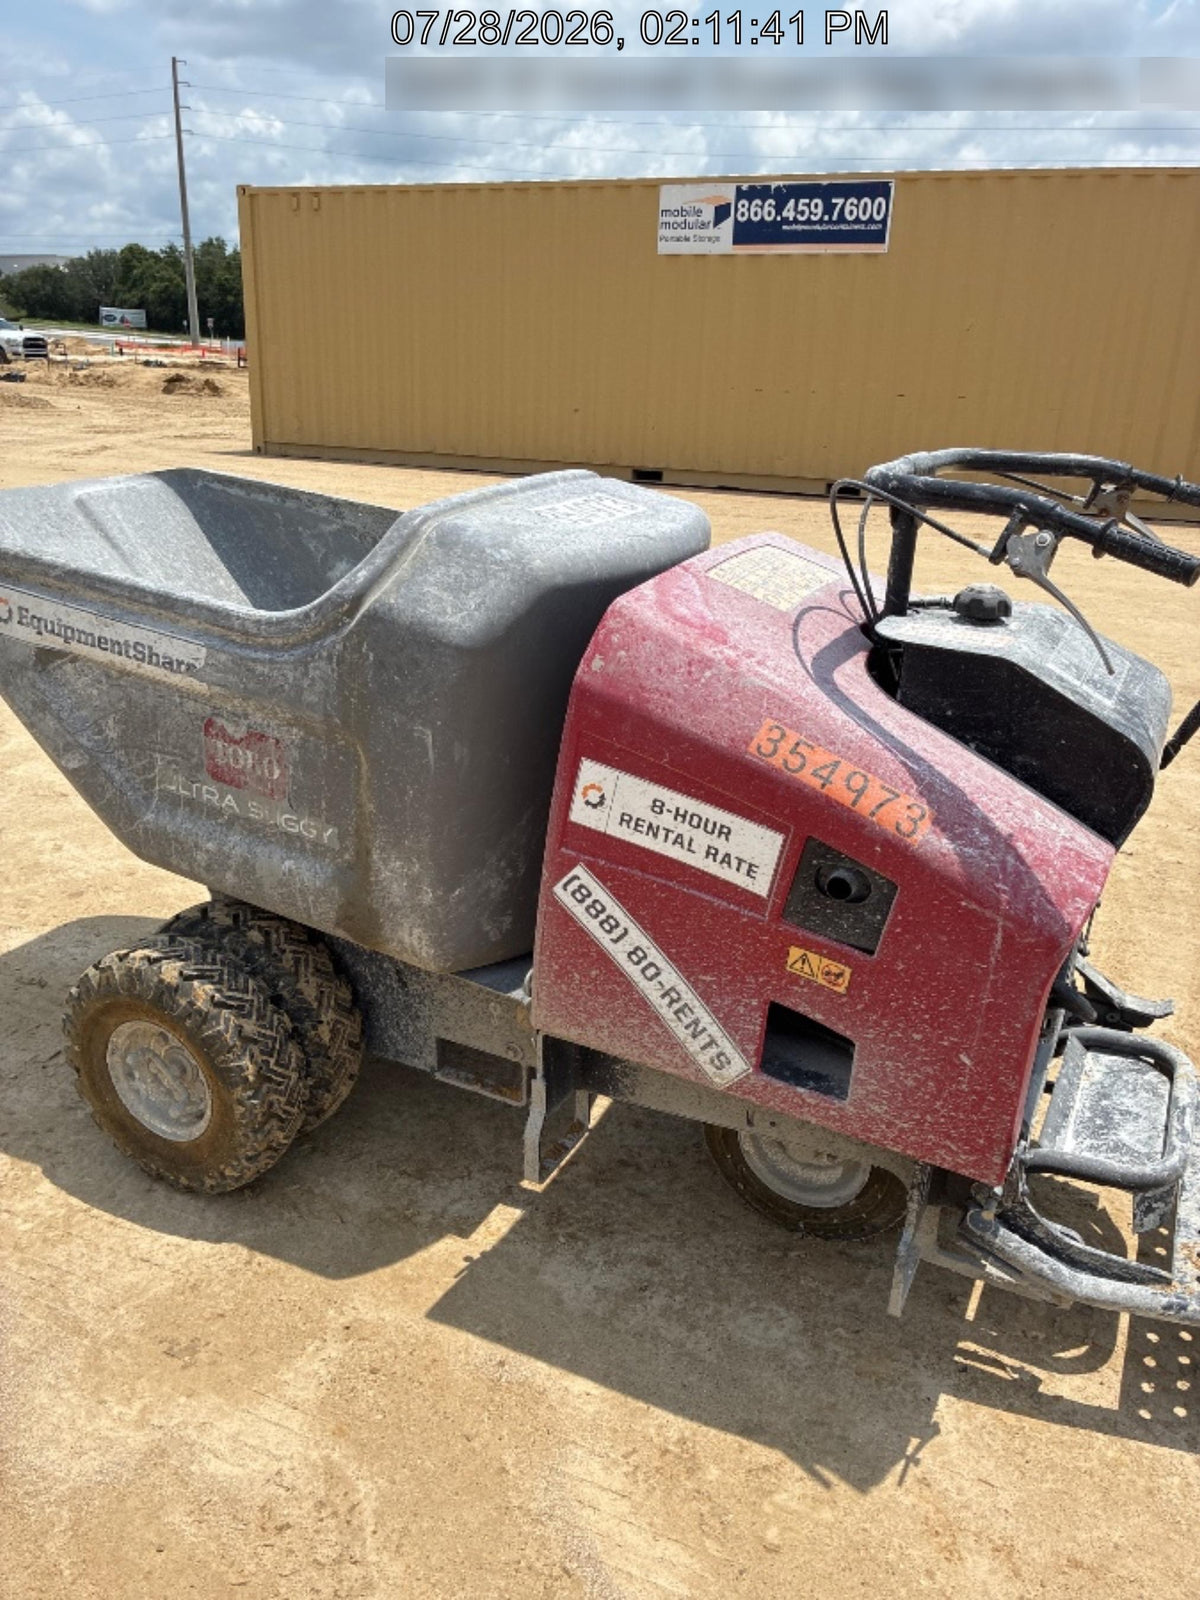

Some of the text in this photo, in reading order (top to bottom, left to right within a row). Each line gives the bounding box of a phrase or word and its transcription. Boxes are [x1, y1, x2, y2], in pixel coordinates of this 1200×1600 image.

[660, 219, 711, 230] modular
[661, 205, 703, 217] mobile
[736, 197, 886, 222] 866.459.7600
[755, 724, 928, 840] 354973
[651, 798, 732, 842] 8-HOUR
[619, 813, 759, 880] RENTAL RATE
[563, 874, 732, 1072] (888) 80-RENTS
